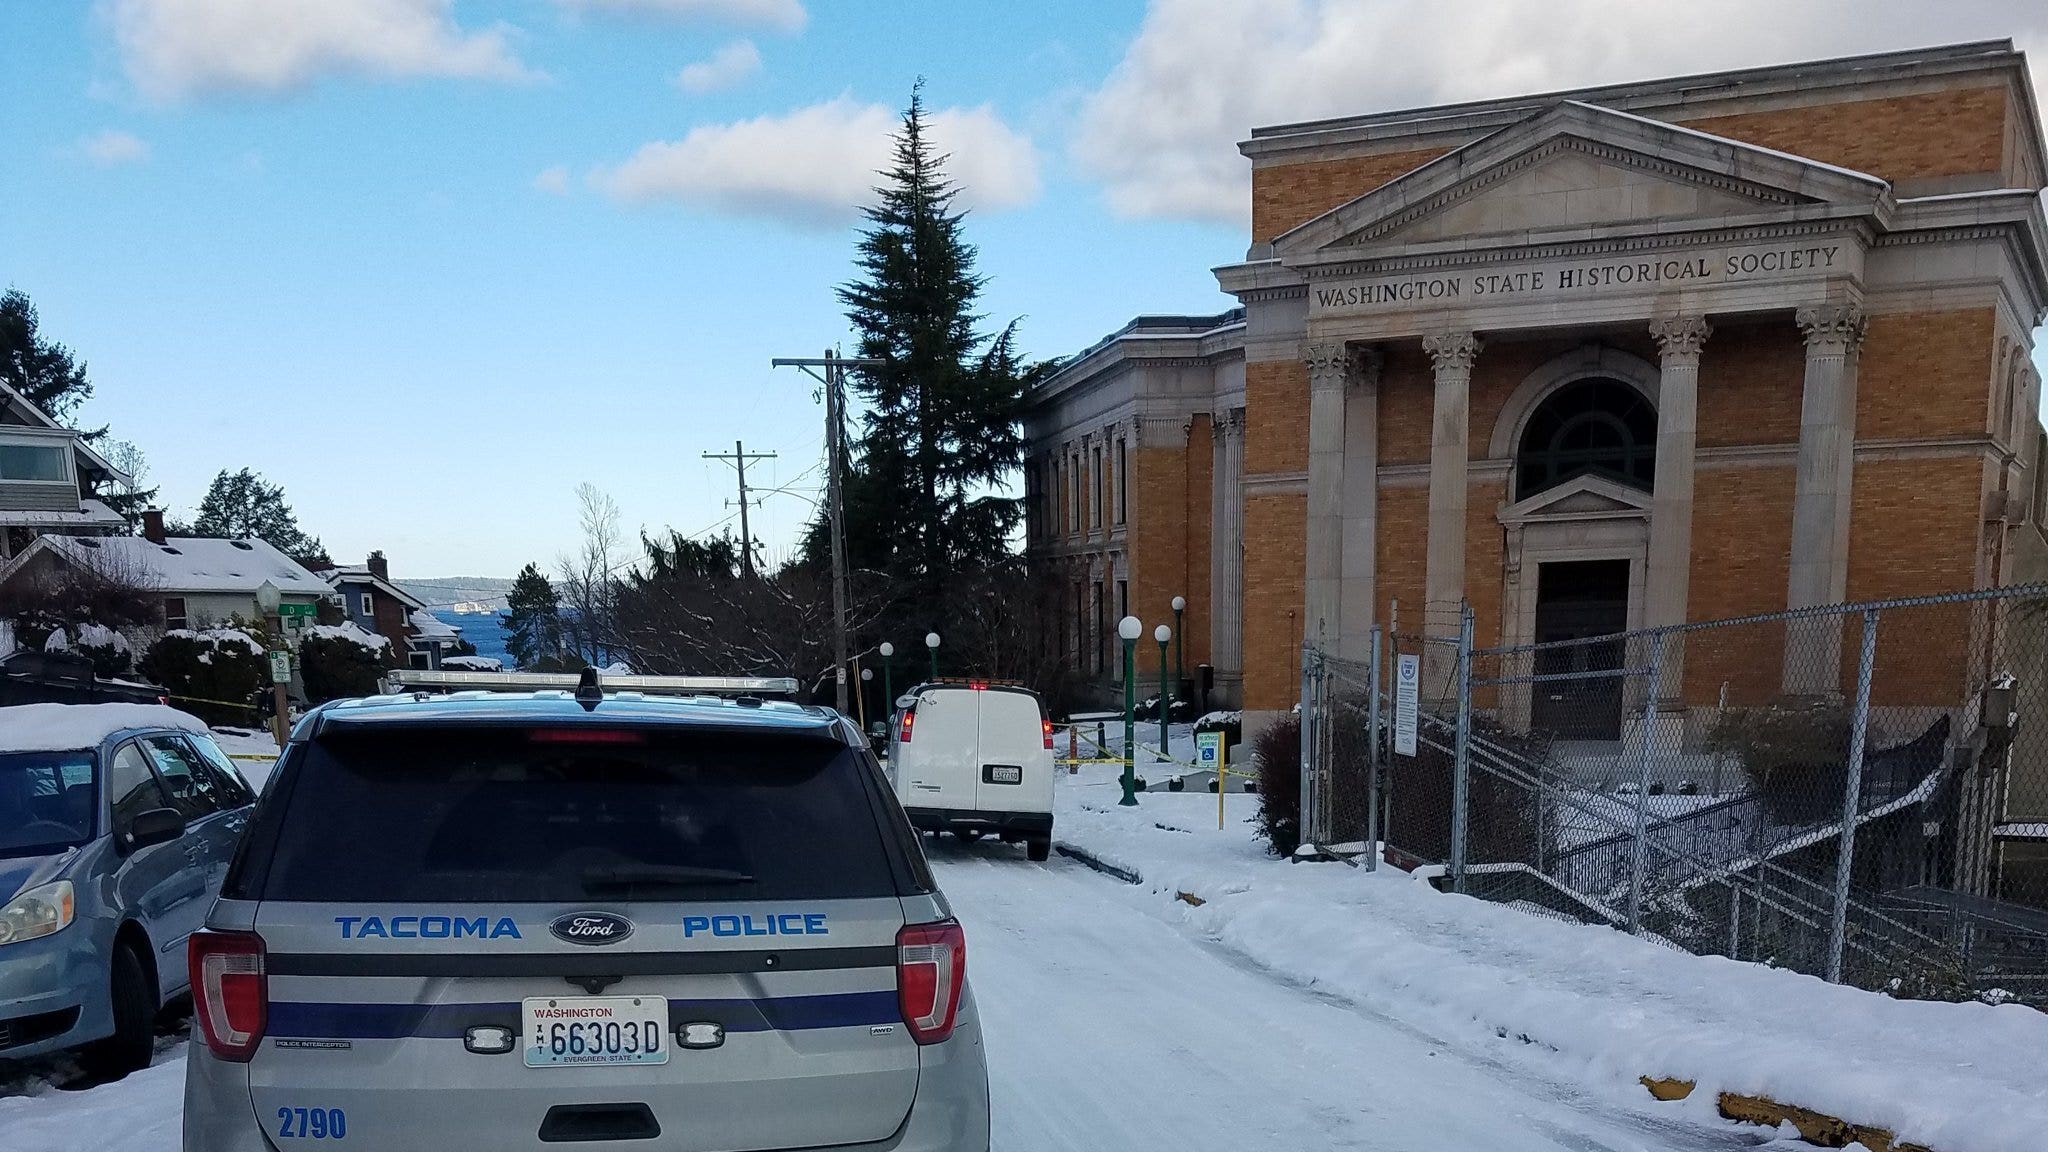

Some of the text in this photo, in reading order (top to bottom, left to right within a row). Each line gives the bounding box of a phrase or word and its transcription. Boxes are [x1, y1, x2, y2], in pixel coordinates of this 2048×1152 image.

[1316, 246, 1839, 308] WASHINGTON STATE HISTORICAL SOCIETY
[334, 916, 522, 939] TACOMA
[568, 917, 614, 936] Ford
[683, 913, 829, 938] POLICE
[534, 1008, 613, 1018] WASHINGTON
[551, 1020, 660, 1055] 66303D
[277, 1107, 346, 1139] 2790
